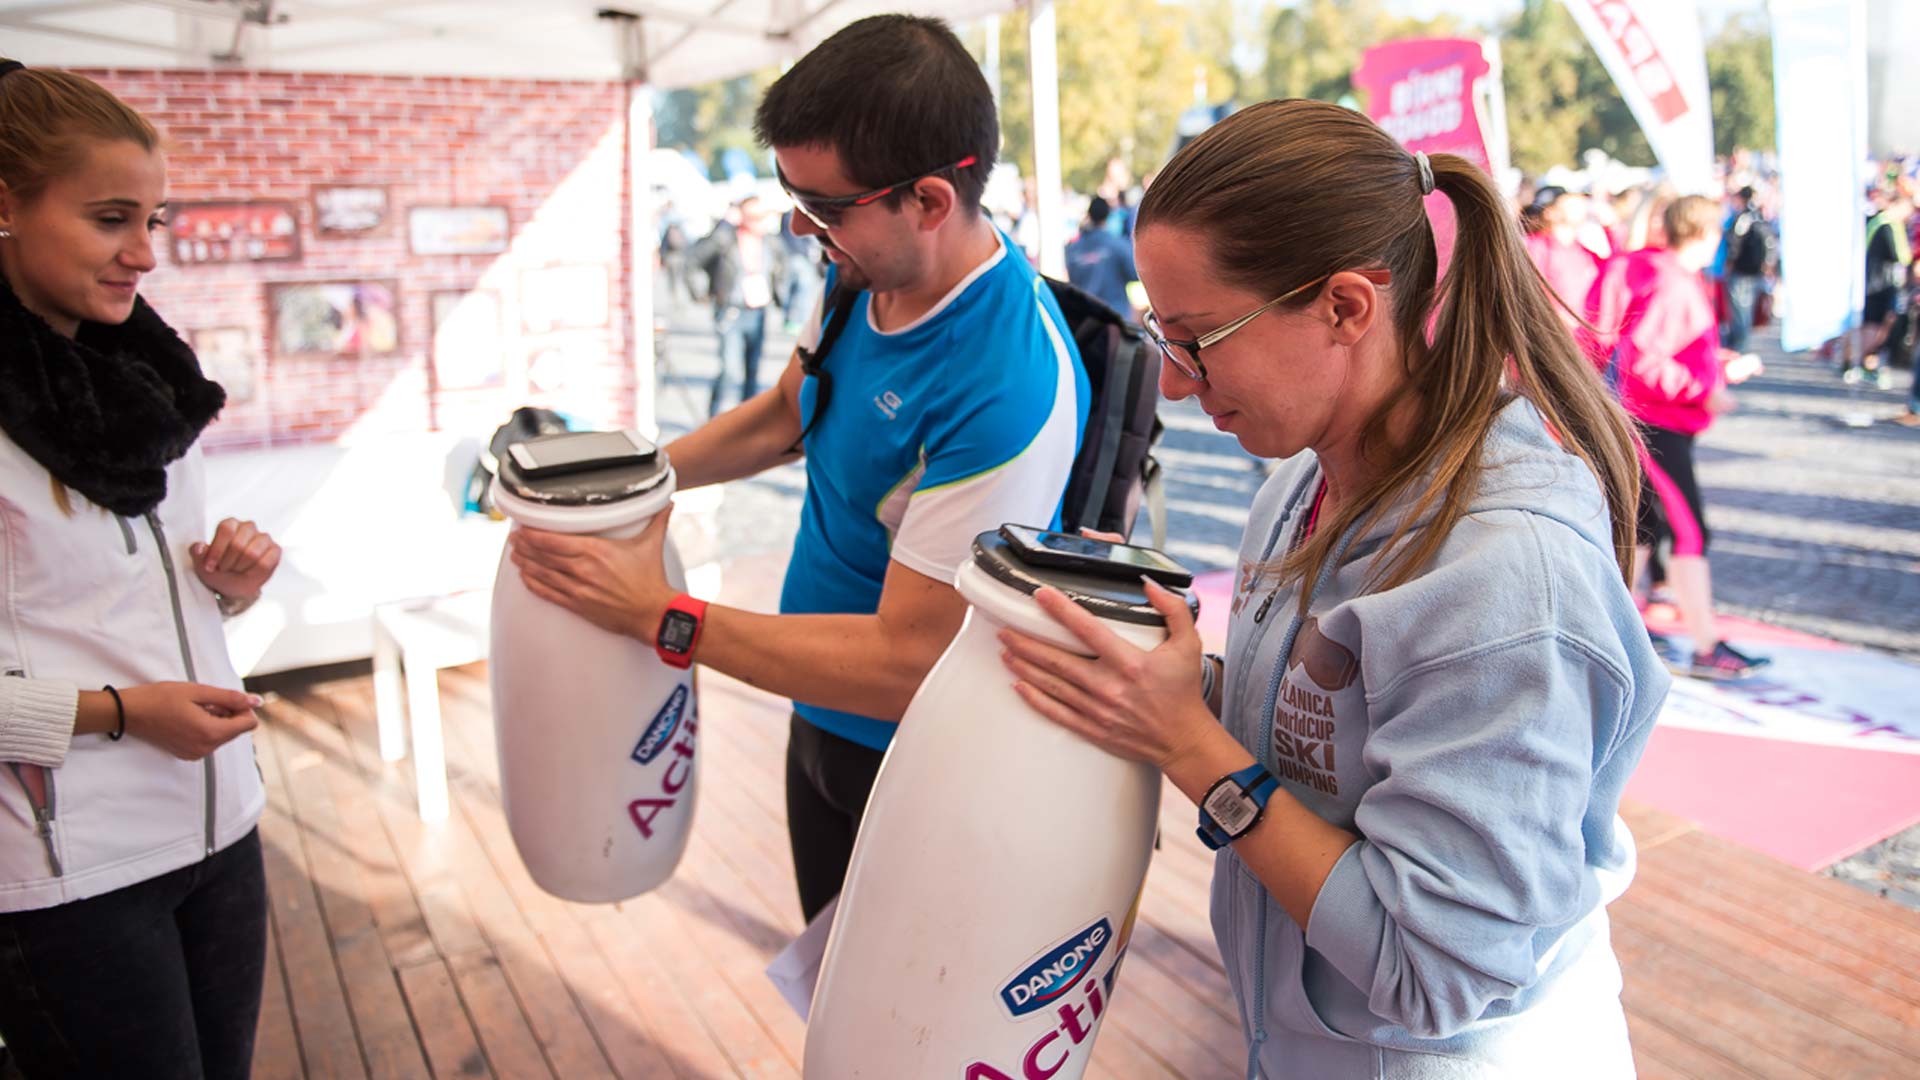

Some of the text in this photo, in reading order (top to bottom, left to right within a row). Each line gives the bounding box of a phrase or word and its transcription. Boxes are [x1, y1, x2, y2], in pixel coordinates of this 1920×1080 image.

[1281, 675, 1335, 718] PLANICA
[1274, 727, 1336, 772] SKI
[628, 706, 698, 840] Acti
[1278, 756, 1338, 796] JUMPING
